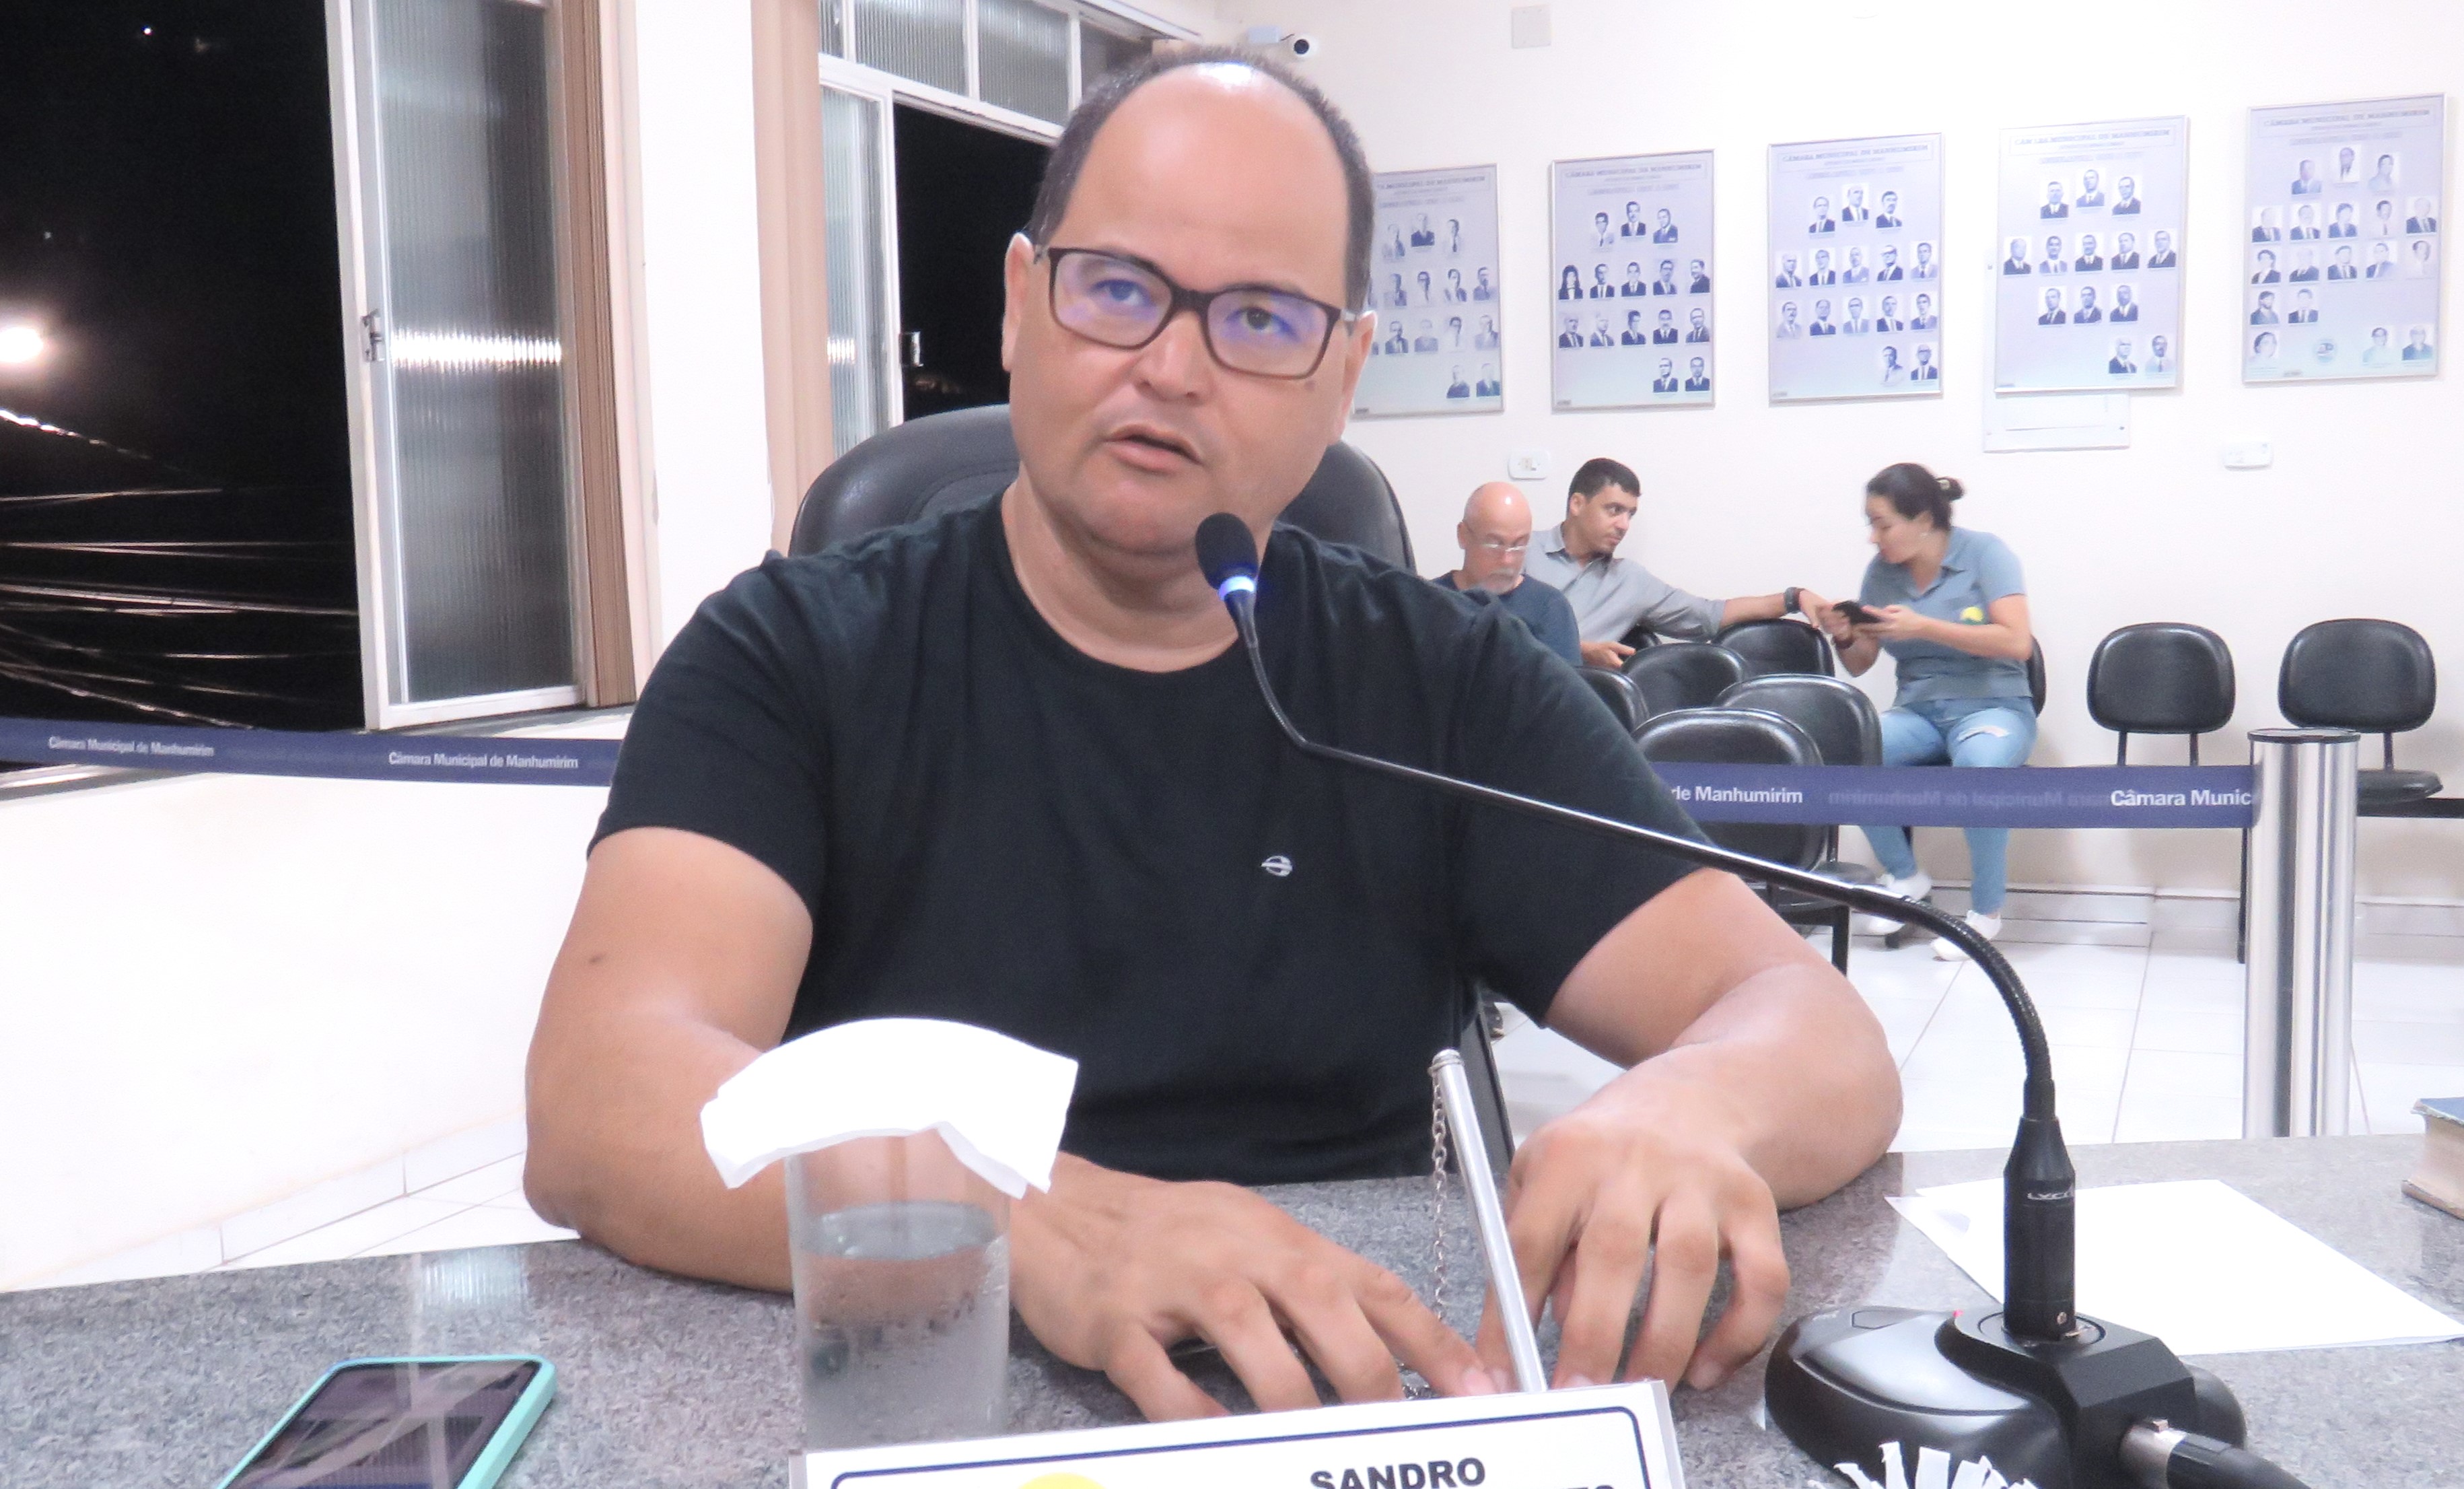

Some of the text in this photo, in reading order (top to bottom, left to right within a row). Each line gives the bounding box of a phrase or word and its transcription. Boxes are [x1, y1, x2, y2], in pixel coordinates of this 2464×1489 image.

[388, 751, 431, 765] Câmara
[434, 753, 487, 769] Municipal
[489, 753, 504, 767] de
[506, 754, 579, 769] Manhumirim
[1695, 786, 1803, 804] Manhumirim
[2111, 788, 2186, 806] Câmara
[1310, 1457, 1486, 1489] SANDRO
